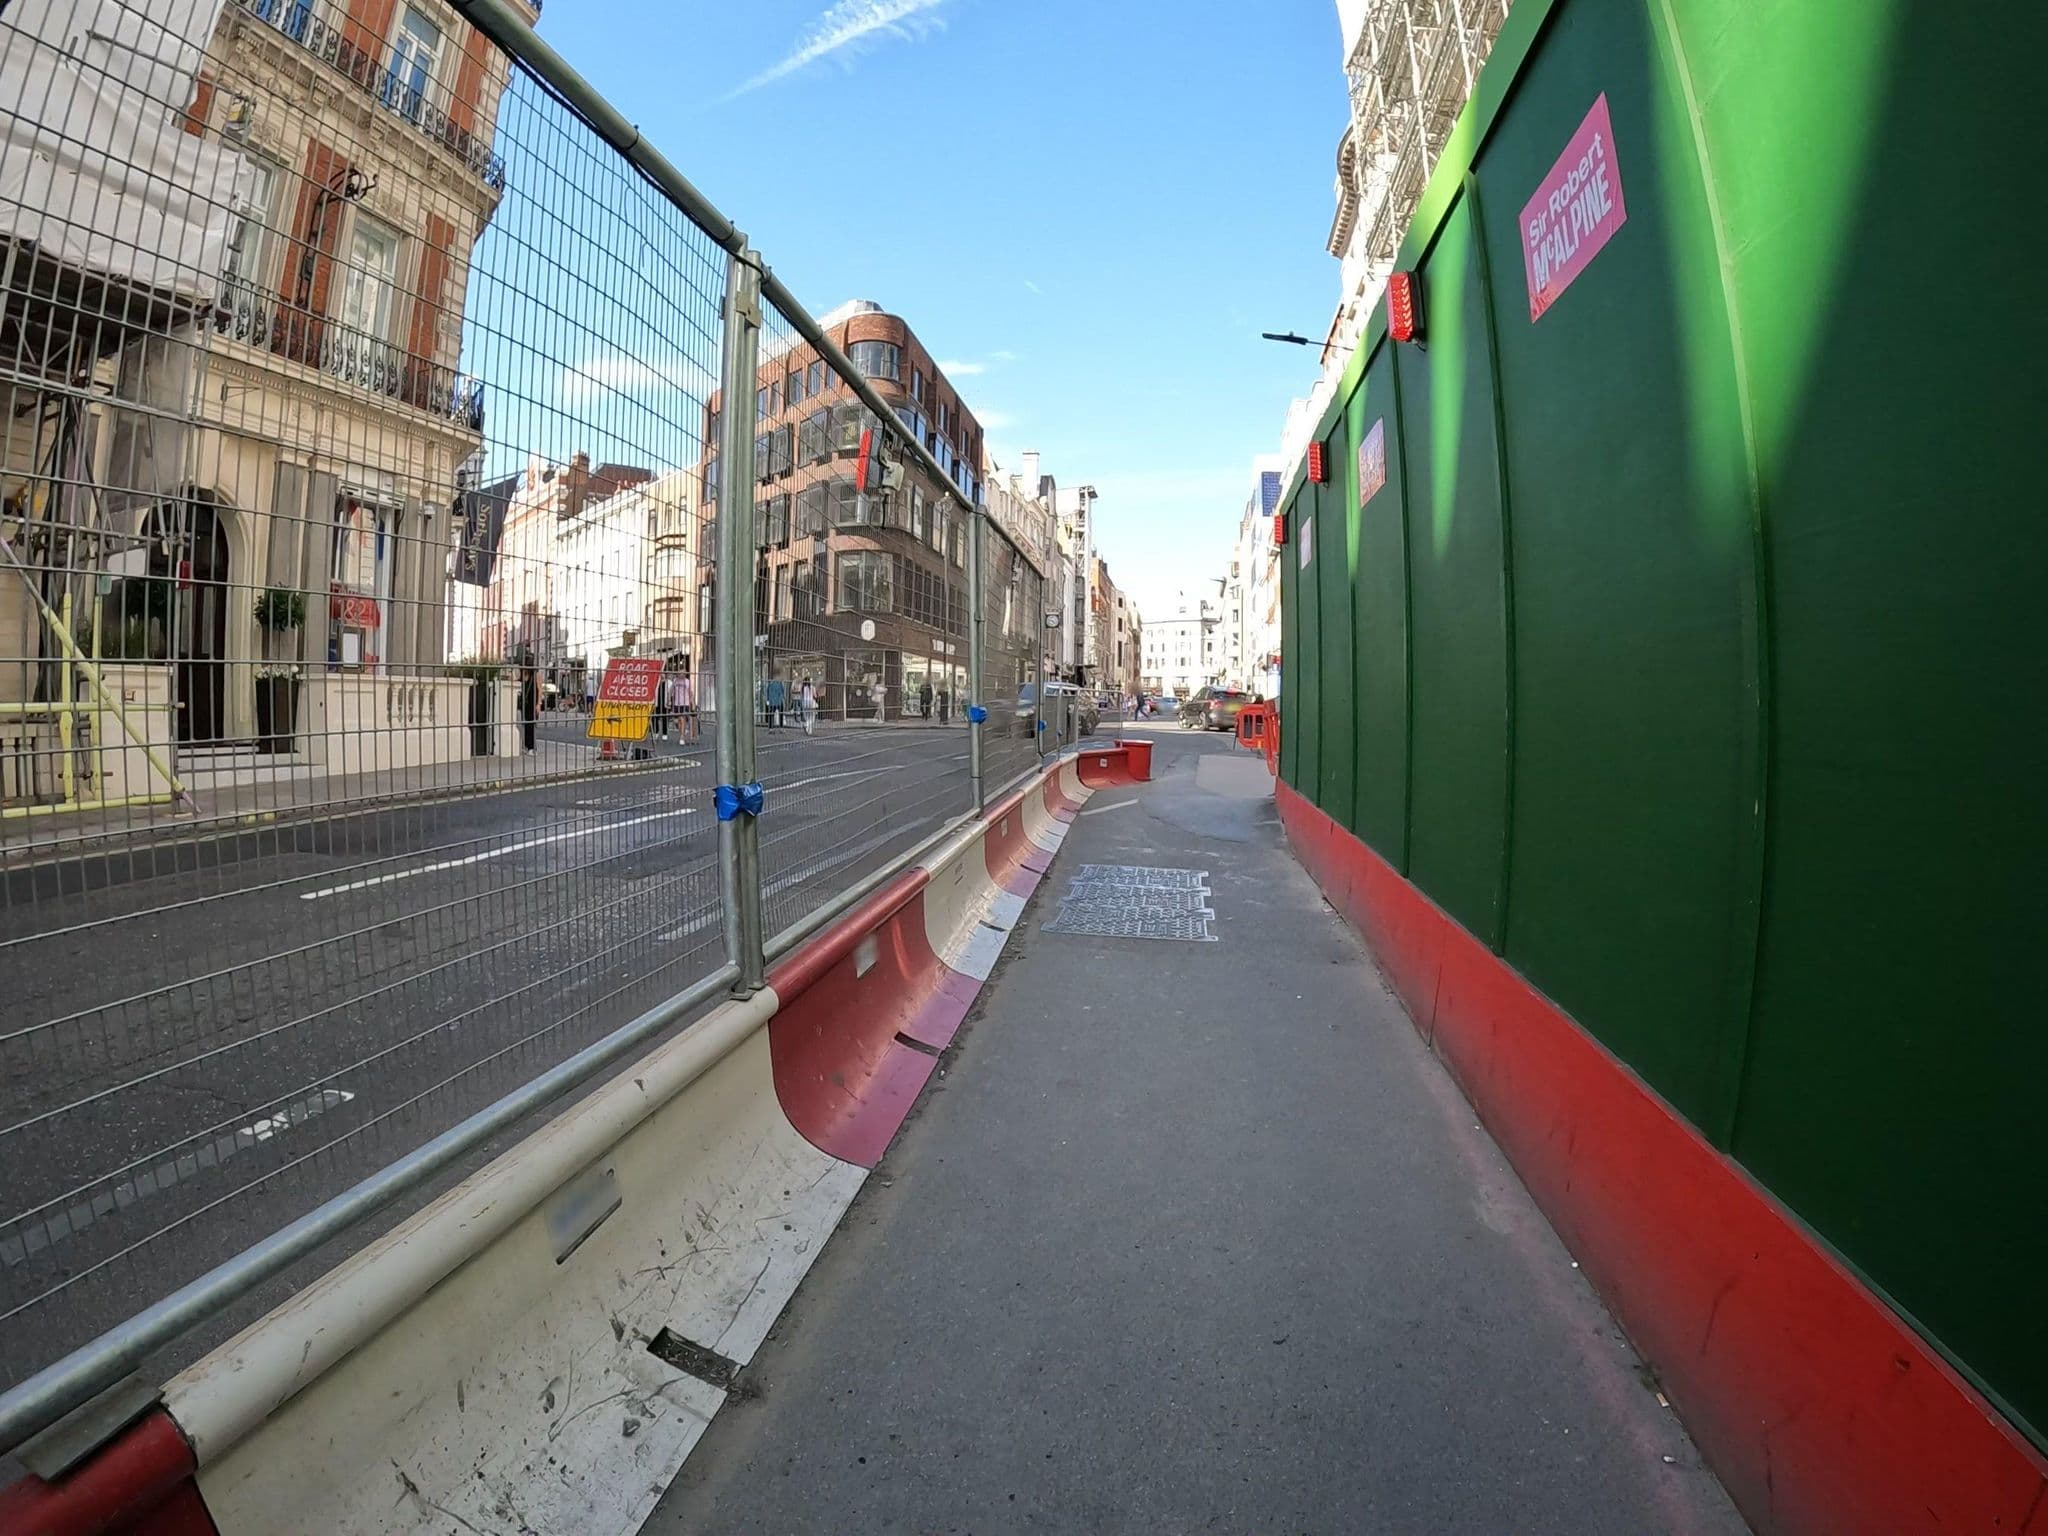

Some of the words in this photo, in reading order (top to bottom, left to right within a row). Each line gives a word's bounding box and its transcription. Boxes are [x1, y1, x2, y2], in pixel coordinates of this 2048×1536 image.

[1529, 210, 1547, 247] Sir
[1548, 132, 1604, 222] Robert
[612, 674, 649, 685] AHEAD
[606, 686, 649, 697] CLOSED
